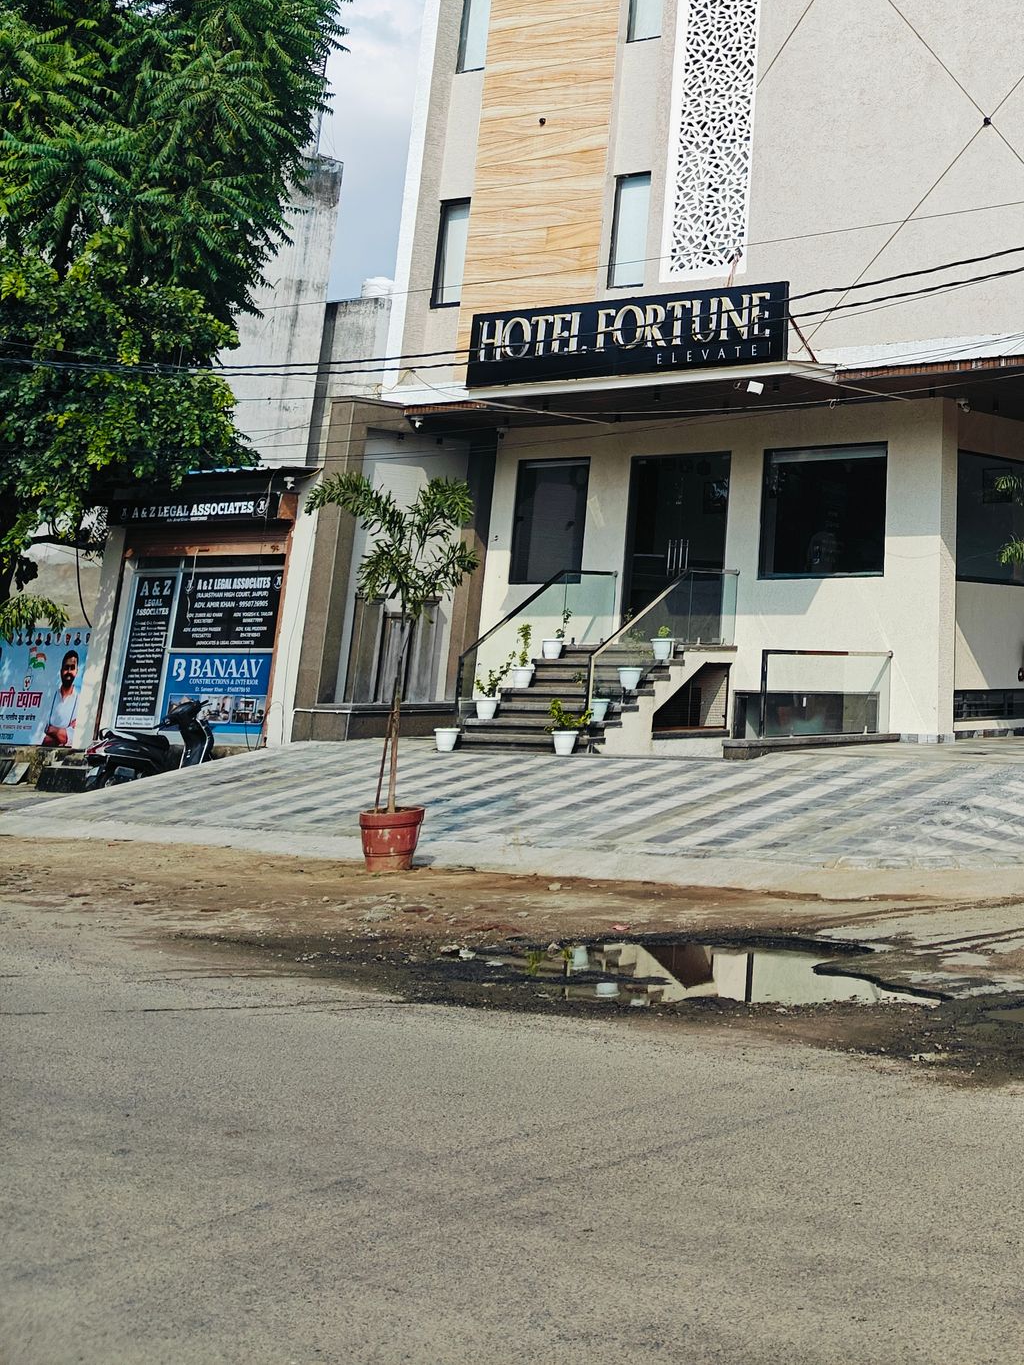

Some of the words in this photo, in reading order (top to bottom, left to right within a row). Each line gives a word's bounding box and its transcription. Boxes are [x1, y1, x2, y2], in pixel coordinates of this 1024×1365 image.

[478, 312, 587, 362] HOTEL
[597, 292, 771, 353] FORTUNE
[132, 507, 139, 518] A
[141, 508, 147, 518] &
[149, 507, 156, 518] Z
[158, 505, 189, 517] LEGAL
[190, 501, 254, 516] ASSOCIATES
[140, 581, 149, 595] A
[152, 581, 160, 595] &
[163, 580, 172, 595] Z
[197, 580, 202, 590] A
[208, 579, 213, 590] Z
[214, 578, 232, 590] LEGAL
[232, 577, 271, 589] ASSOCIATES
[144, 599, 163, 607] LEGAL
[136, 608, 169, 616] ASSOCIATES
[189, 659, 263, 678] BANAAV
